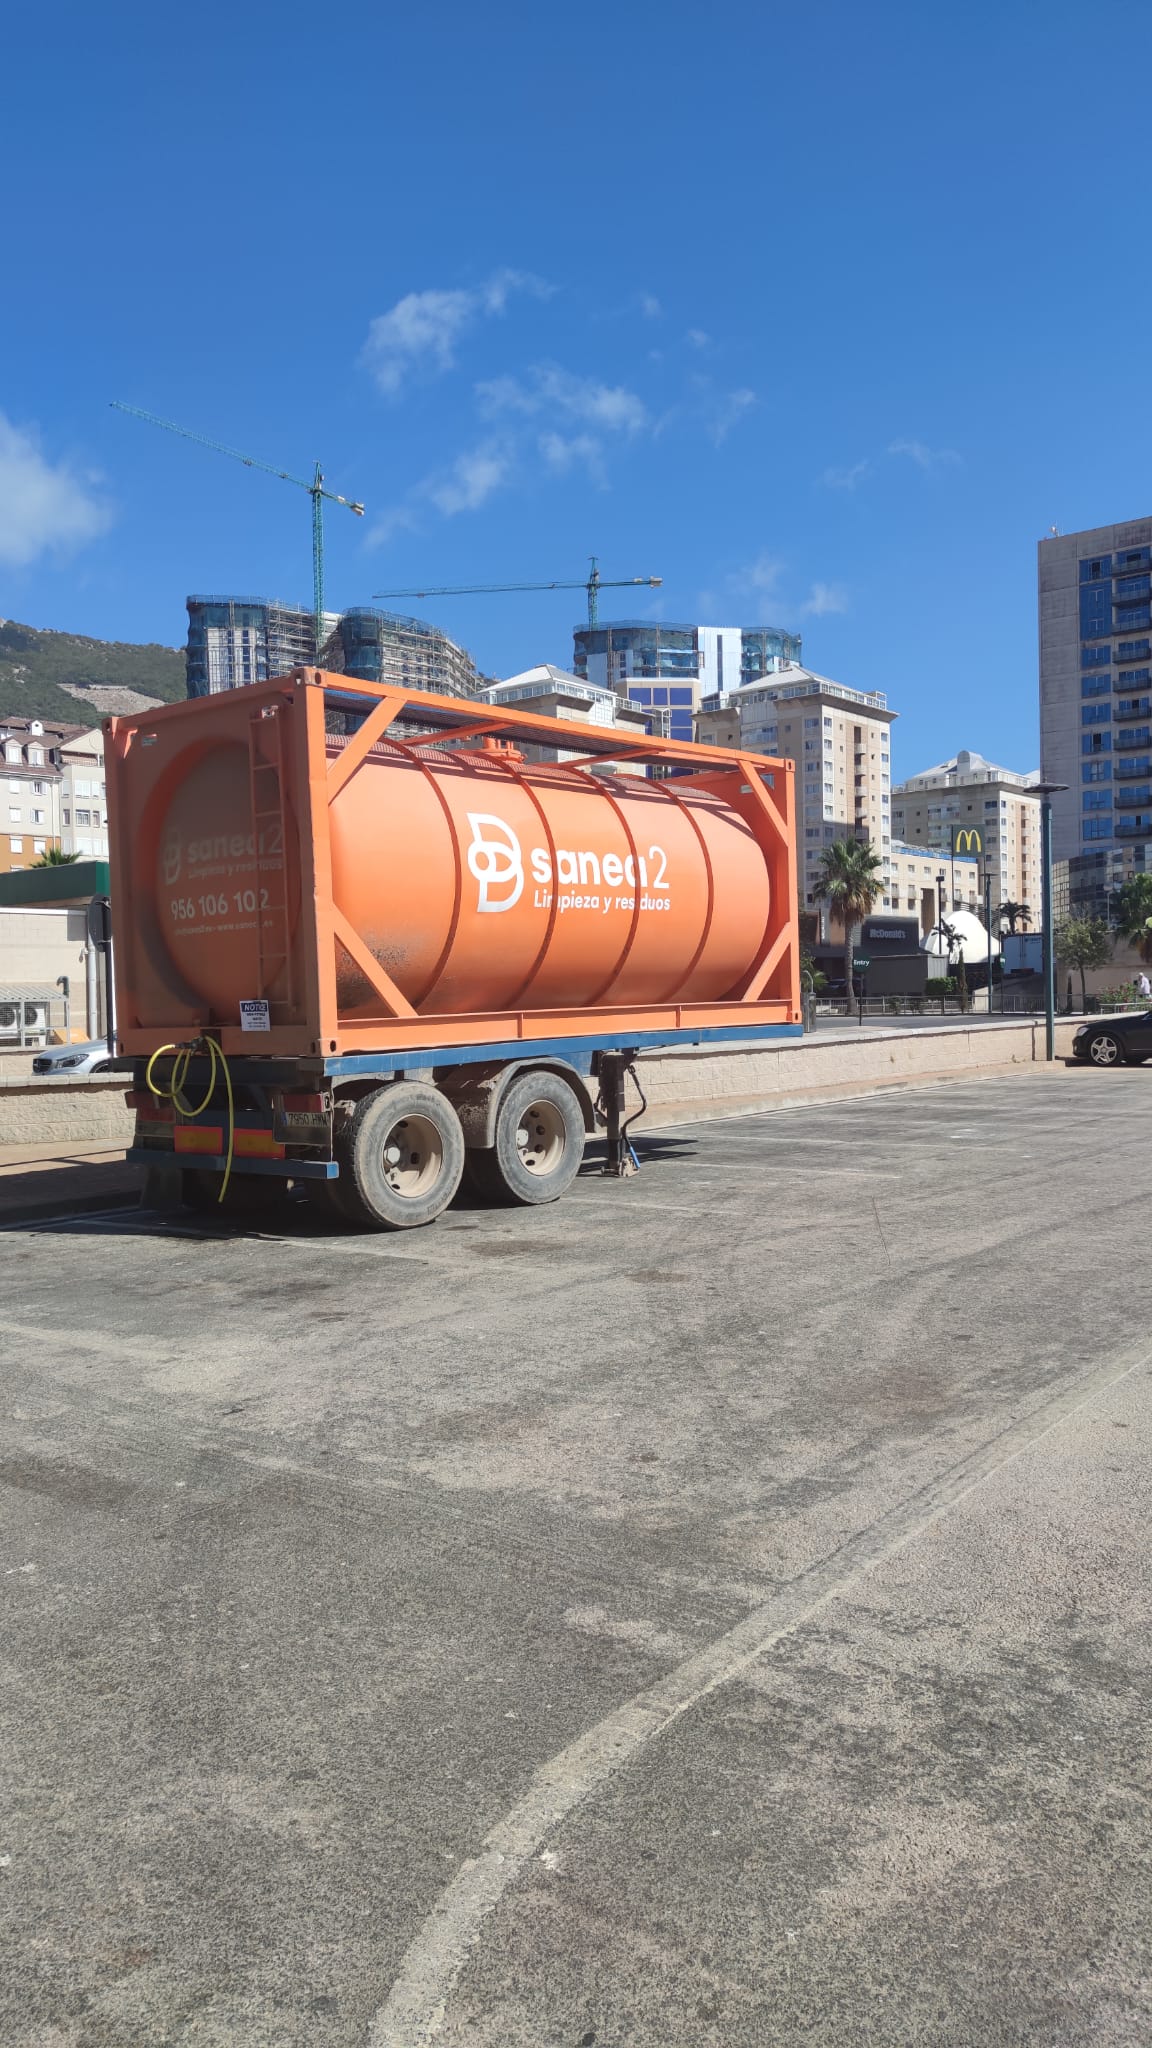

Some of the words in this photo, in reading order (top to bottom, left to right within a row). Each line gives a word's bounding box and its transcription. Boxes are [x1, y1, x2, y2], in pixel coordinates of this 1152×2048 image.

[171, 897, 196, 920] 956
[198, 893, 228, 917] 106
[233, 888, 270, 913] 102
[602, 897, 611, 914] y
[615, 892, 671, 911] resduos
[869, 929, 906, 939] McDonald's
[853, 959, 870, 967] Entry
